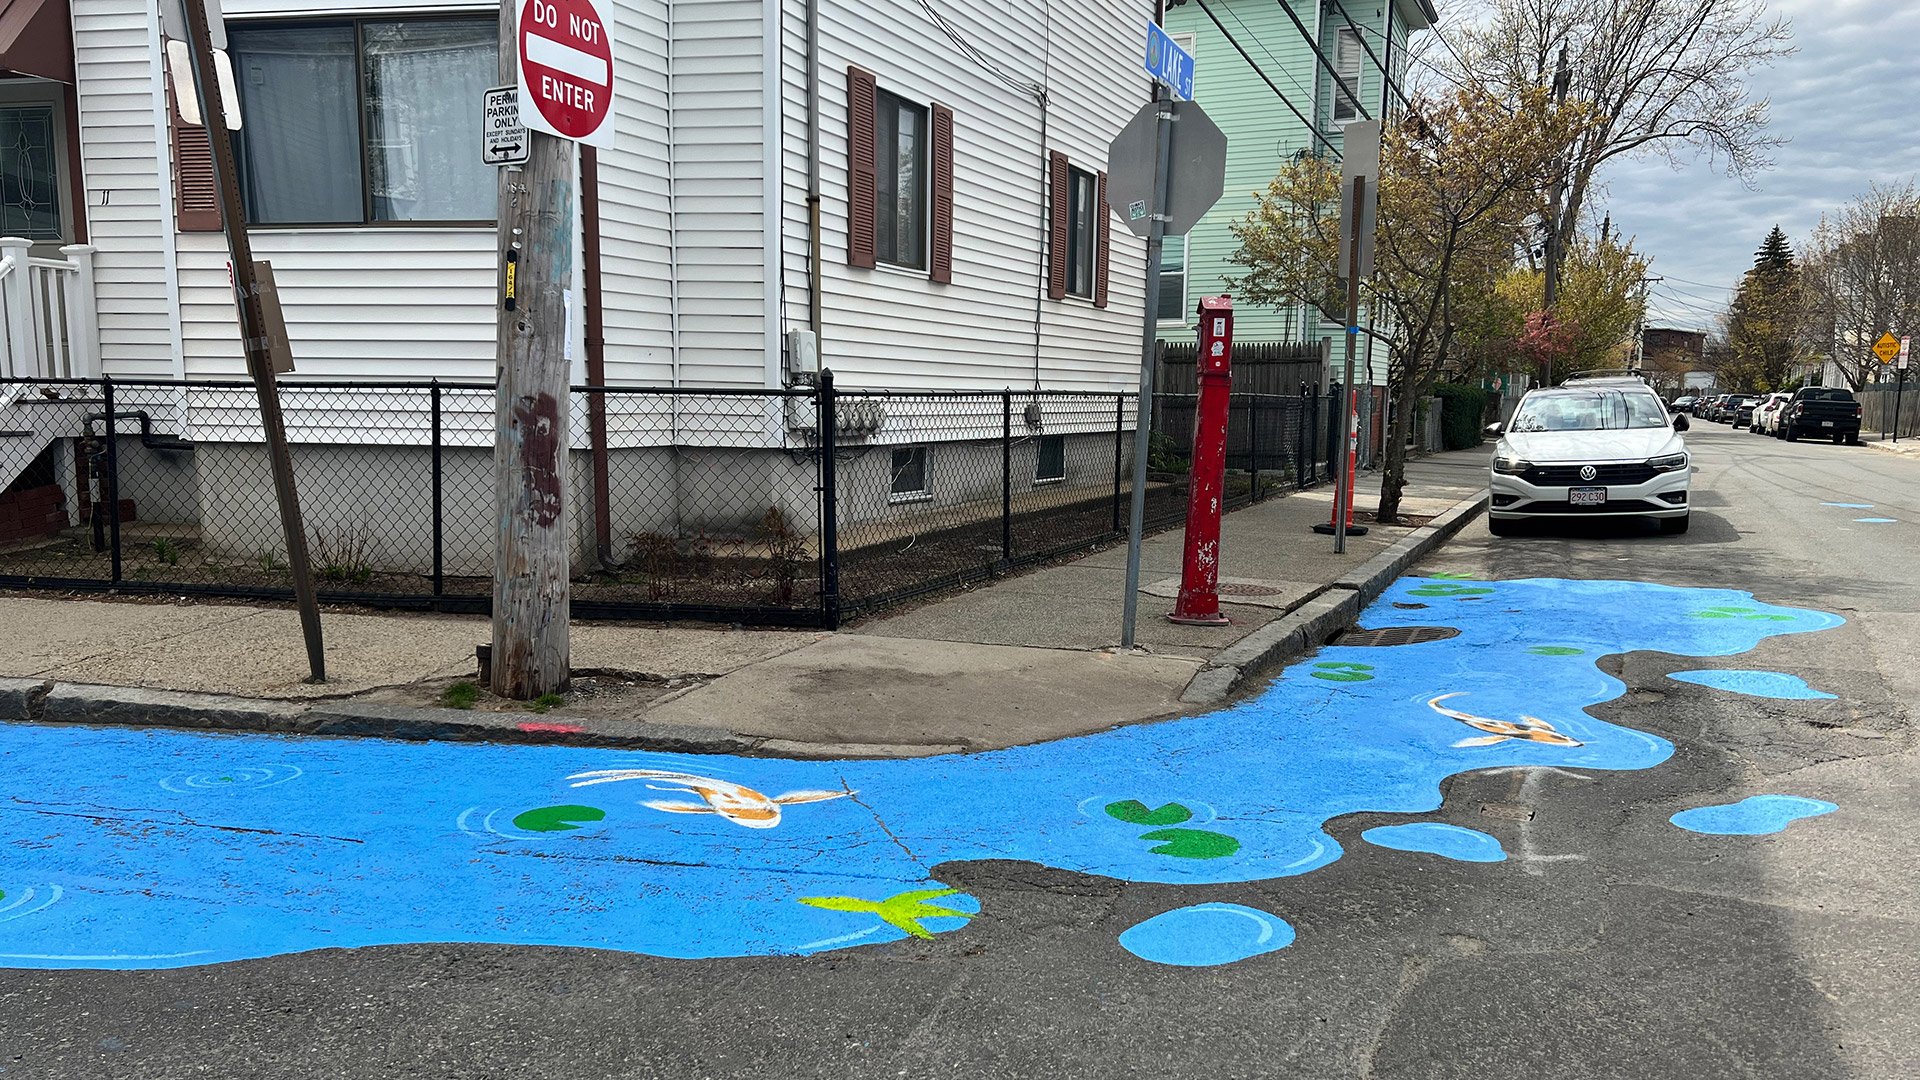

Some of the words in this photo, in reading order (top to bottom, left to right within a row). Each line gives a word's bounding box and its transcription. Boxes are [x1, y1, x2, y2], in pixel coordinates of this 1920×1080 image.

[534, 0, 557, 29] DO
[569, 12, 600, 45] NOT
[1162, 40, 1183, 90] LAKE
[1184, 77, 1192, 97] ST
[490, 93, 518, 106] PERMI
[542, 74, 595, 113] ENTER
[487, 105, 519, 118] PARKIN
[494, 117, 518, 129] ONLY
[486, 130, 504, 138] EXCEPT
[505, 128, 526, 136] SUNDAYS
[501, 135, 523, 143] HOLIDAYS
[1571, 492, 1587, 502] 292
[1588, 492, 1604, 502] C30
